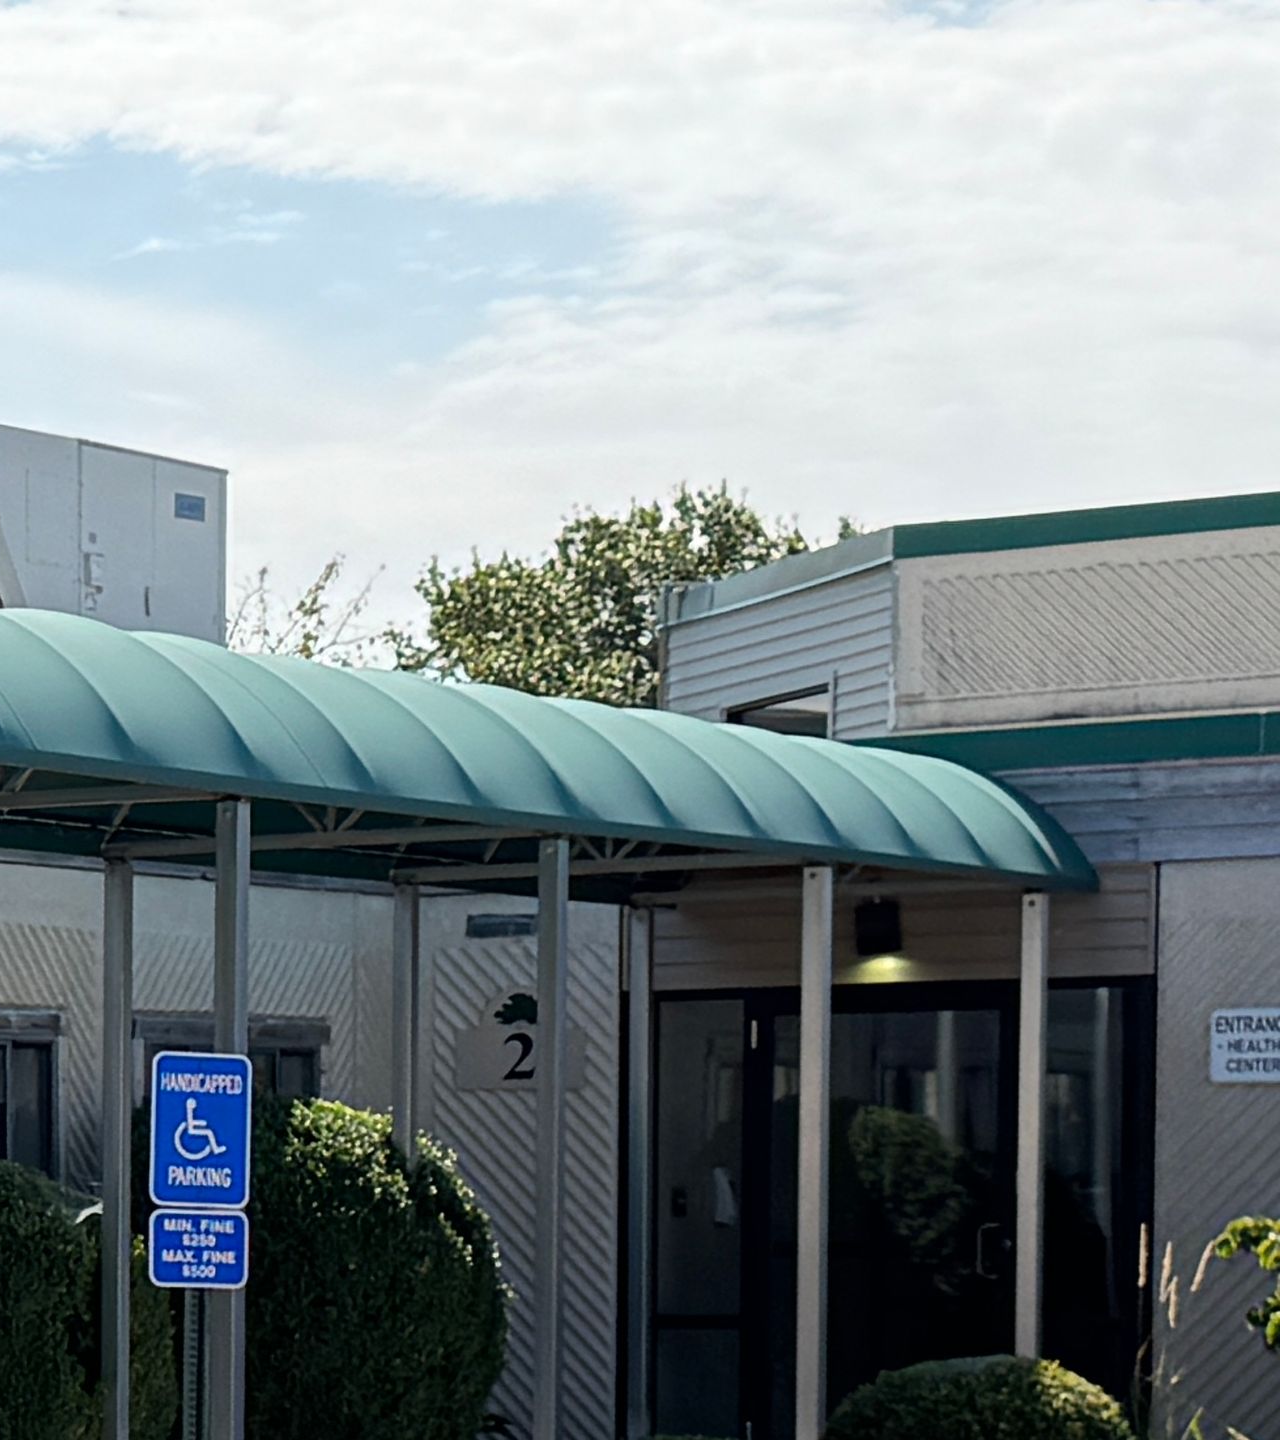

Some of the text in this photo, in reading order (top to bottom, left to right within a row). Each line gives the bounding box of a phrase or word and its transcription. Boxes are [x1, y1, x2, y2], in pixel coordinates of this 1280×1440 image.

[502, 1032, 537, 1081] 2
[160, 1072, 243, 1095] HANDICAPPED
[168, 1165, 232, 1188] PARKING
[164, 1218, 235, 1234] MIN. FINE
[161, 1249, 237, 1265] MAX. FINE
